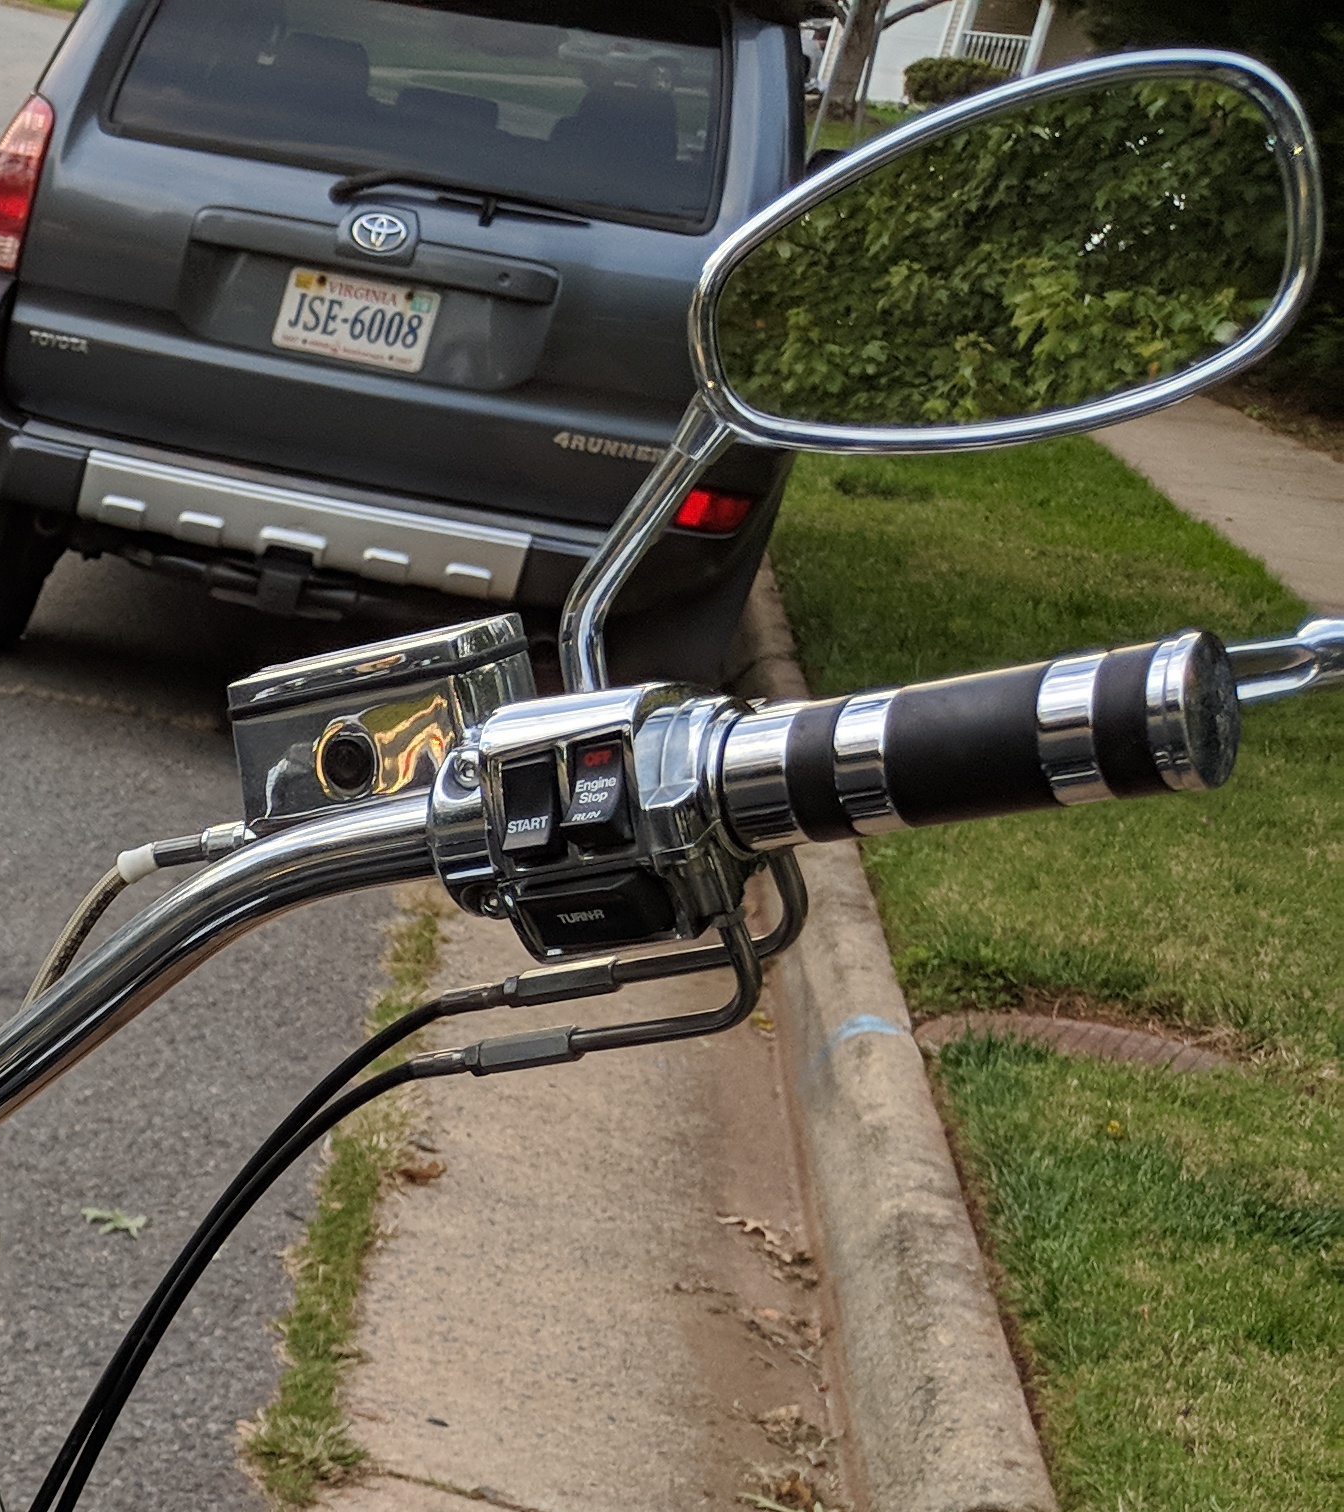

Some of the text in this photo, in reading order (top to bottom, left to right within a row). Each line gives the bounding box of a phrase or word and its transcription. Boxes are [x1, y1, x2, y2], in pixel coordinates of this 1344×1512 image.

[328, 281, 398, 308] VIRGINIA
[288, 292, 424, 349] JSE-6008
[583, 748, 612, 767] OFF
[574, 776, 617, 796] Engine
[578, 790, 609, 804] Stop
[507, 814, 549, 834] START
[571, 809, 602, 822] RUN
